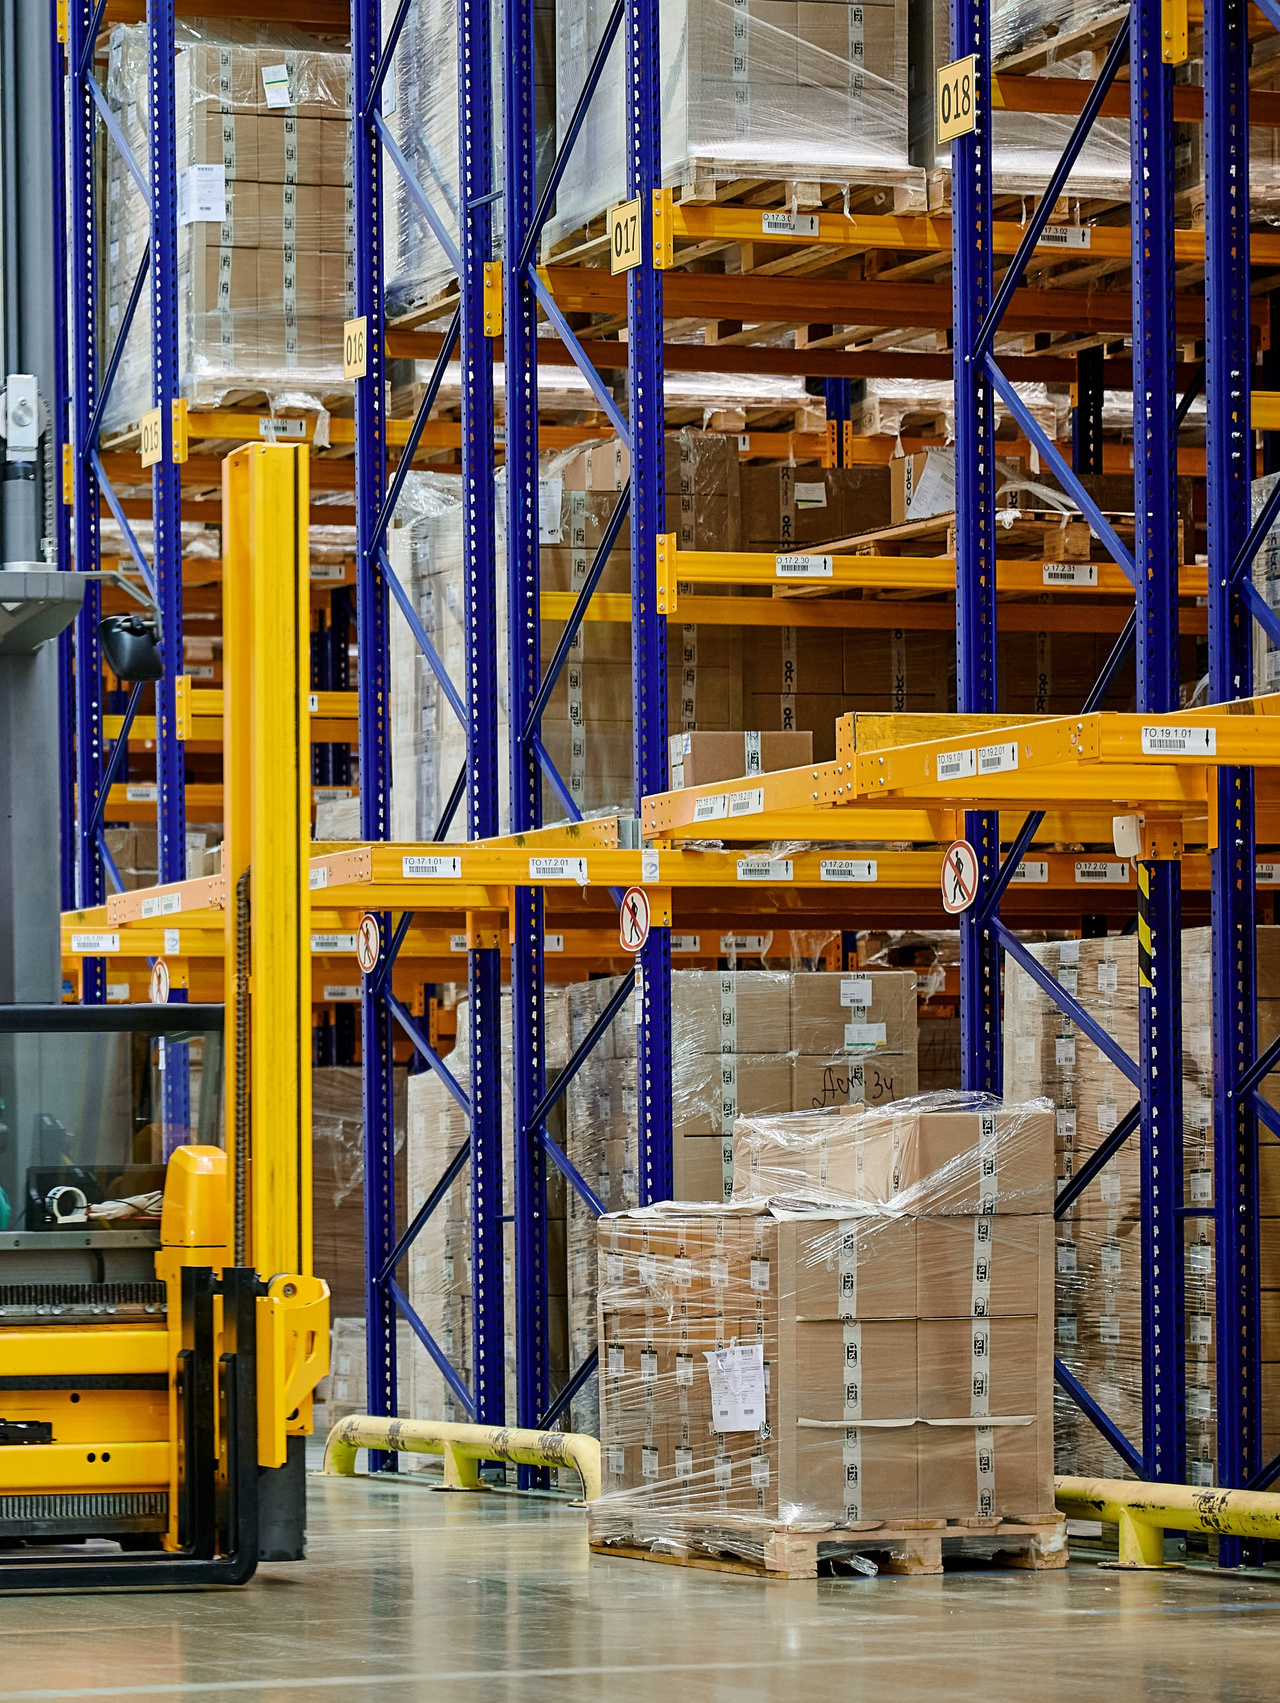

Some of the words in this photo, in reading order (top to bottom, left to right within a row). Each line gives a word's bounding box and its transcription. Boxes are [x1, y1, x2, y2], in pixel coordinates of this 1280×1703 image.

[941, 74, 971, 124] 018
[762, 213, 795, 222] O.17.3.0
[614, 215, 637, 257] 017
[346, 331, 364, 366] 016
[144, 421, 159, 453] 015
[776, 556, 810, 565] O.17.2.30
[1143, 729, 1192, 738] TO.19.1.01
[404, 857, 443, 866] TO.17.1.01
[531, 858, 569, 867] TO.17.2.01
[821, 860, 853, 869] O.17.2.01
